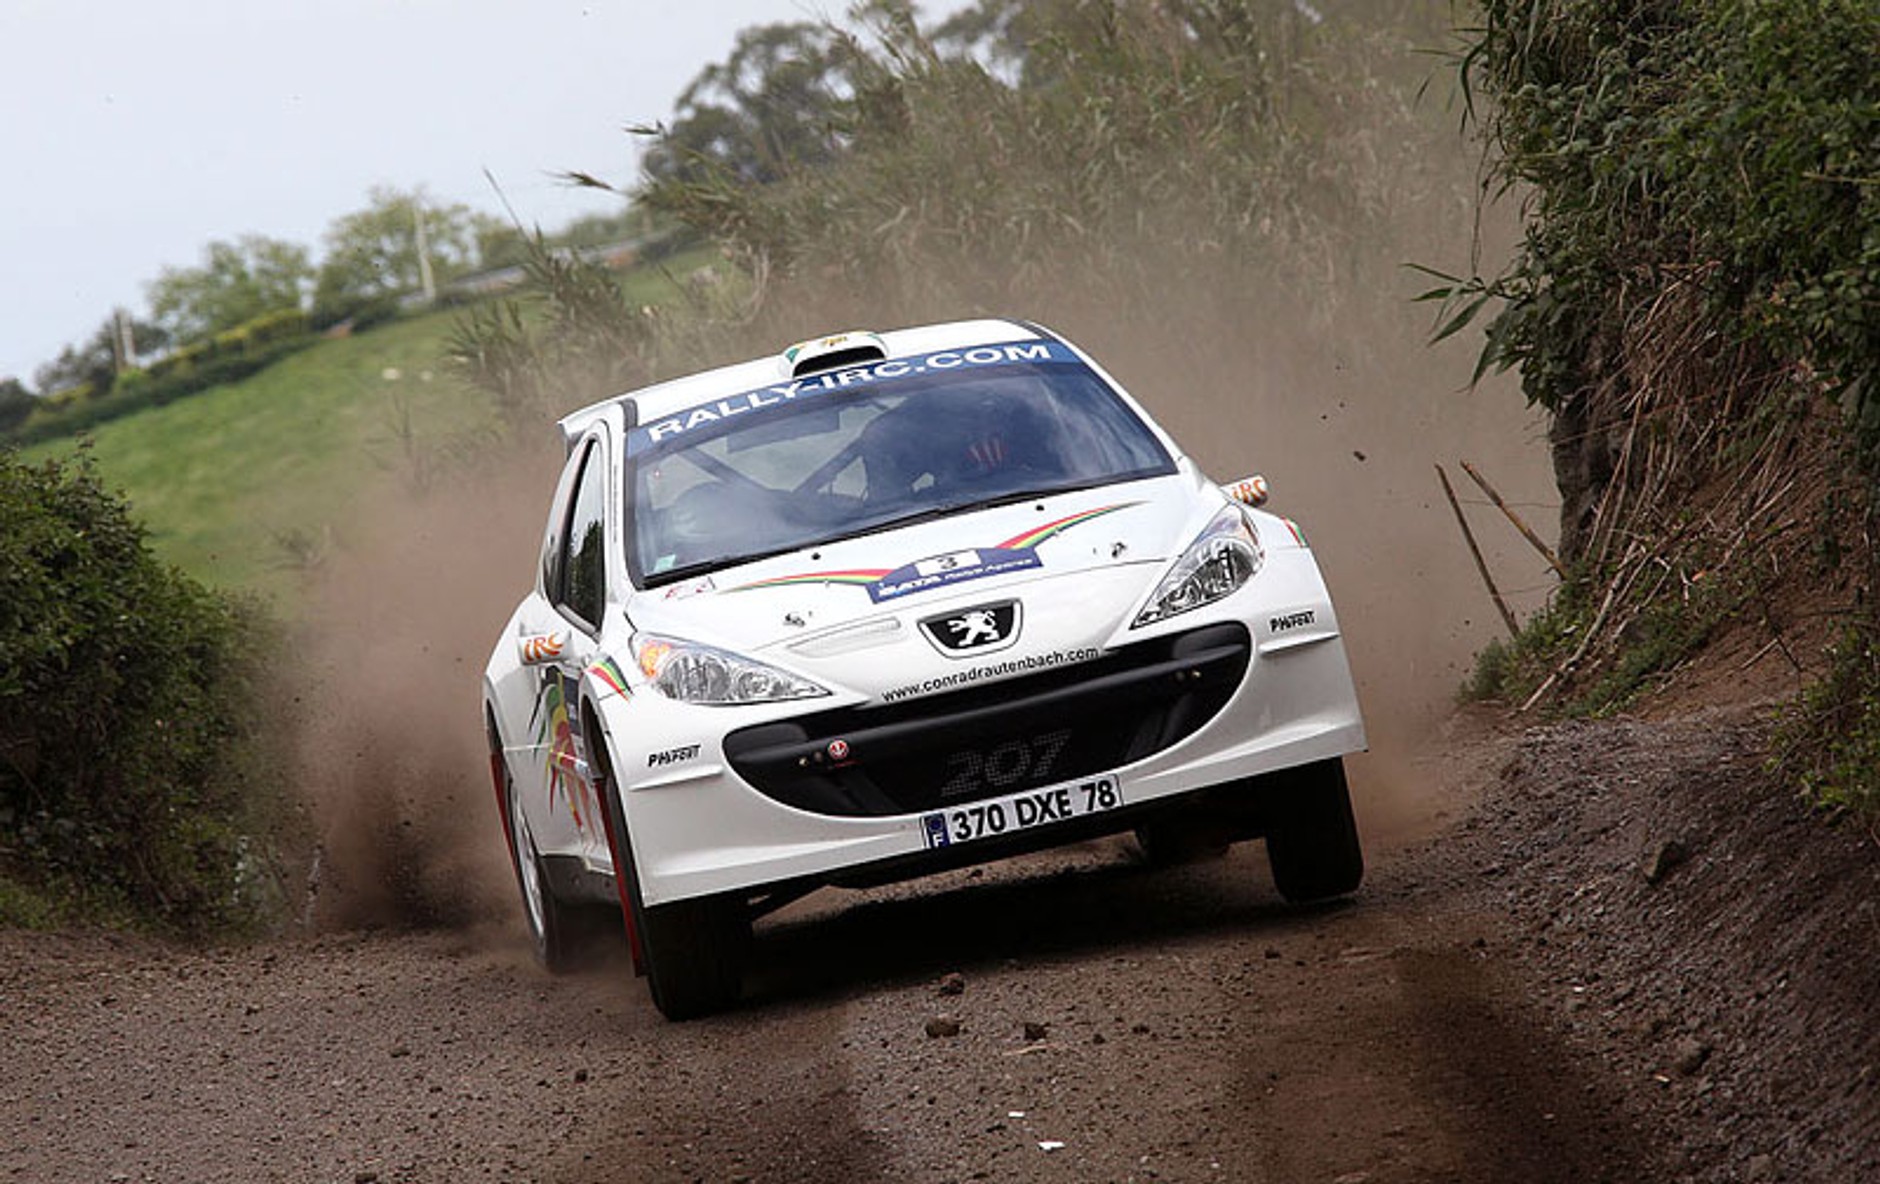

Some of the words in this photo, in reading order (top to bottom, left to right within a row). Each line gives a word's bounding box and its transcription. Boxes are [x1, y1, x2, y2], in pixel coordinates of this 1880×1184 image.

[648, 343, 1052, 443] RALLY-IRC.COM
[937, 556, 958, 569] 3
[881, 647, 1099, 702] www.conradrautenbach.com
[940, 728, 1072, 797] 207
[933, 832, 945, 848] F
[952, 804, 1006, 840] 370
[1013, 790, 1073, 828] DXE
[1081, 780, 1116, 811] 78
